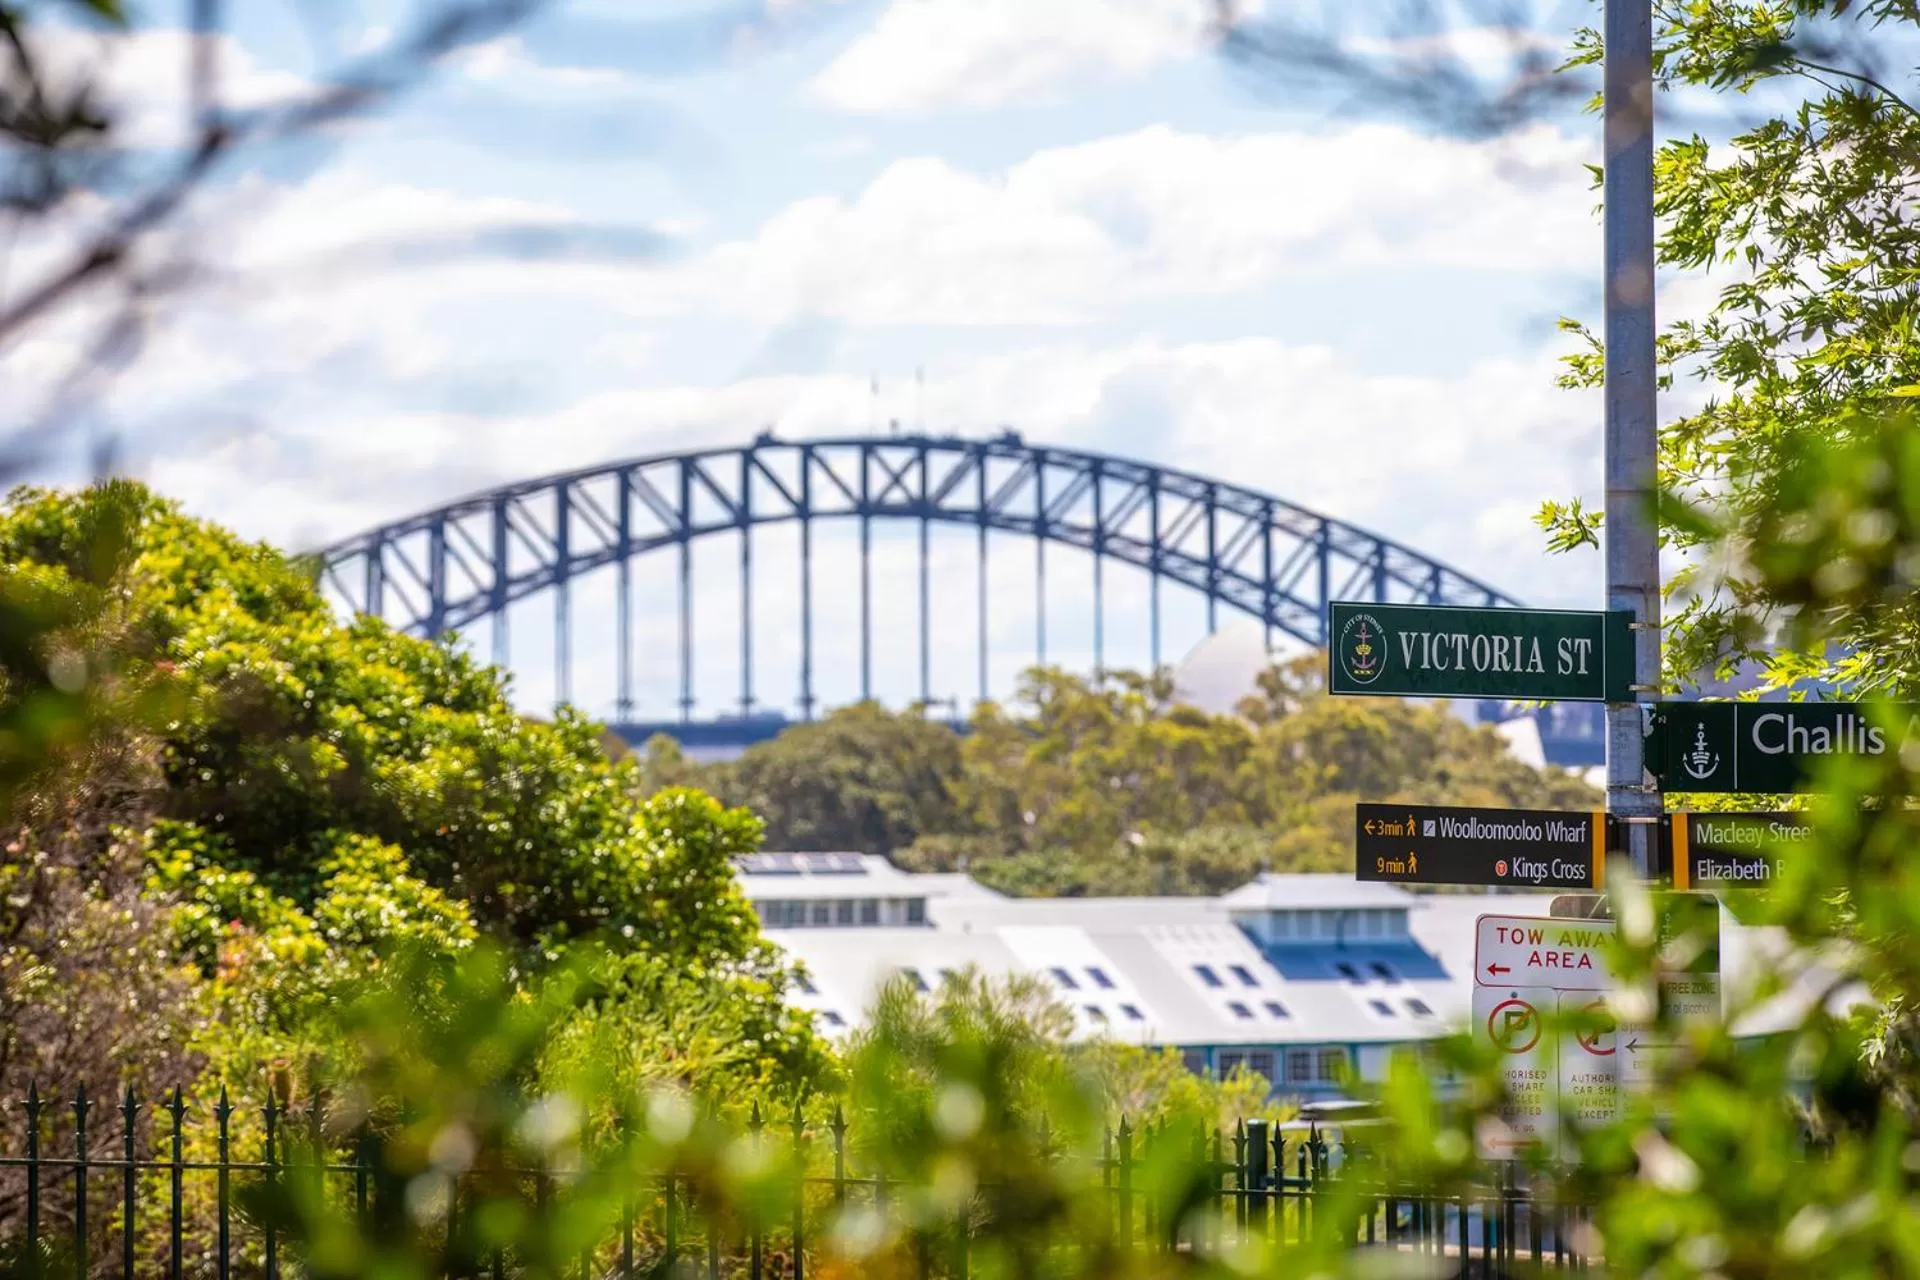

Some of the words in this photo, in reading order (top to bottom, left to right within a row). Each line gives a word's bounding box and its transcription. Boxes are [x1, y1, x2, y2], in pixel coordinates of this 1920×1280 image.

[1343, 615, 1355, 633] CITY
[1355, 613, 1363, 622] OF
[1363, 613, 1384, 635] SYDNEY
[1398, 631, 1545, 673] VICTORIA
[1557, 637, 1592, 676] ST
[1751, 712, 1886, 755] Challis
[1439, 816, 1543, 841] Woolloomooloo
[1544, 820, 1587, 843] Wharf
[1696, 821, 1765, 849] Macleay
[1512, 856, 1548, 884] Kings
[1551, 860, 1587, 880] Cross
[1697, 857, 1770, 881] Elizabeth
[1496, 926, 1544, 945] TOW
[1527, 950, 1593, 970] AREA
[1503, 1069, 1548, 1080] HORISED
[1570, 1073, 1617, 1083] AUTHORI
[1572, 1085, 1593, 1095] CAR
[1598, 1086, 1617, 1095] SHA
[1577, 1110, 1616, 1120] EXCEPT
